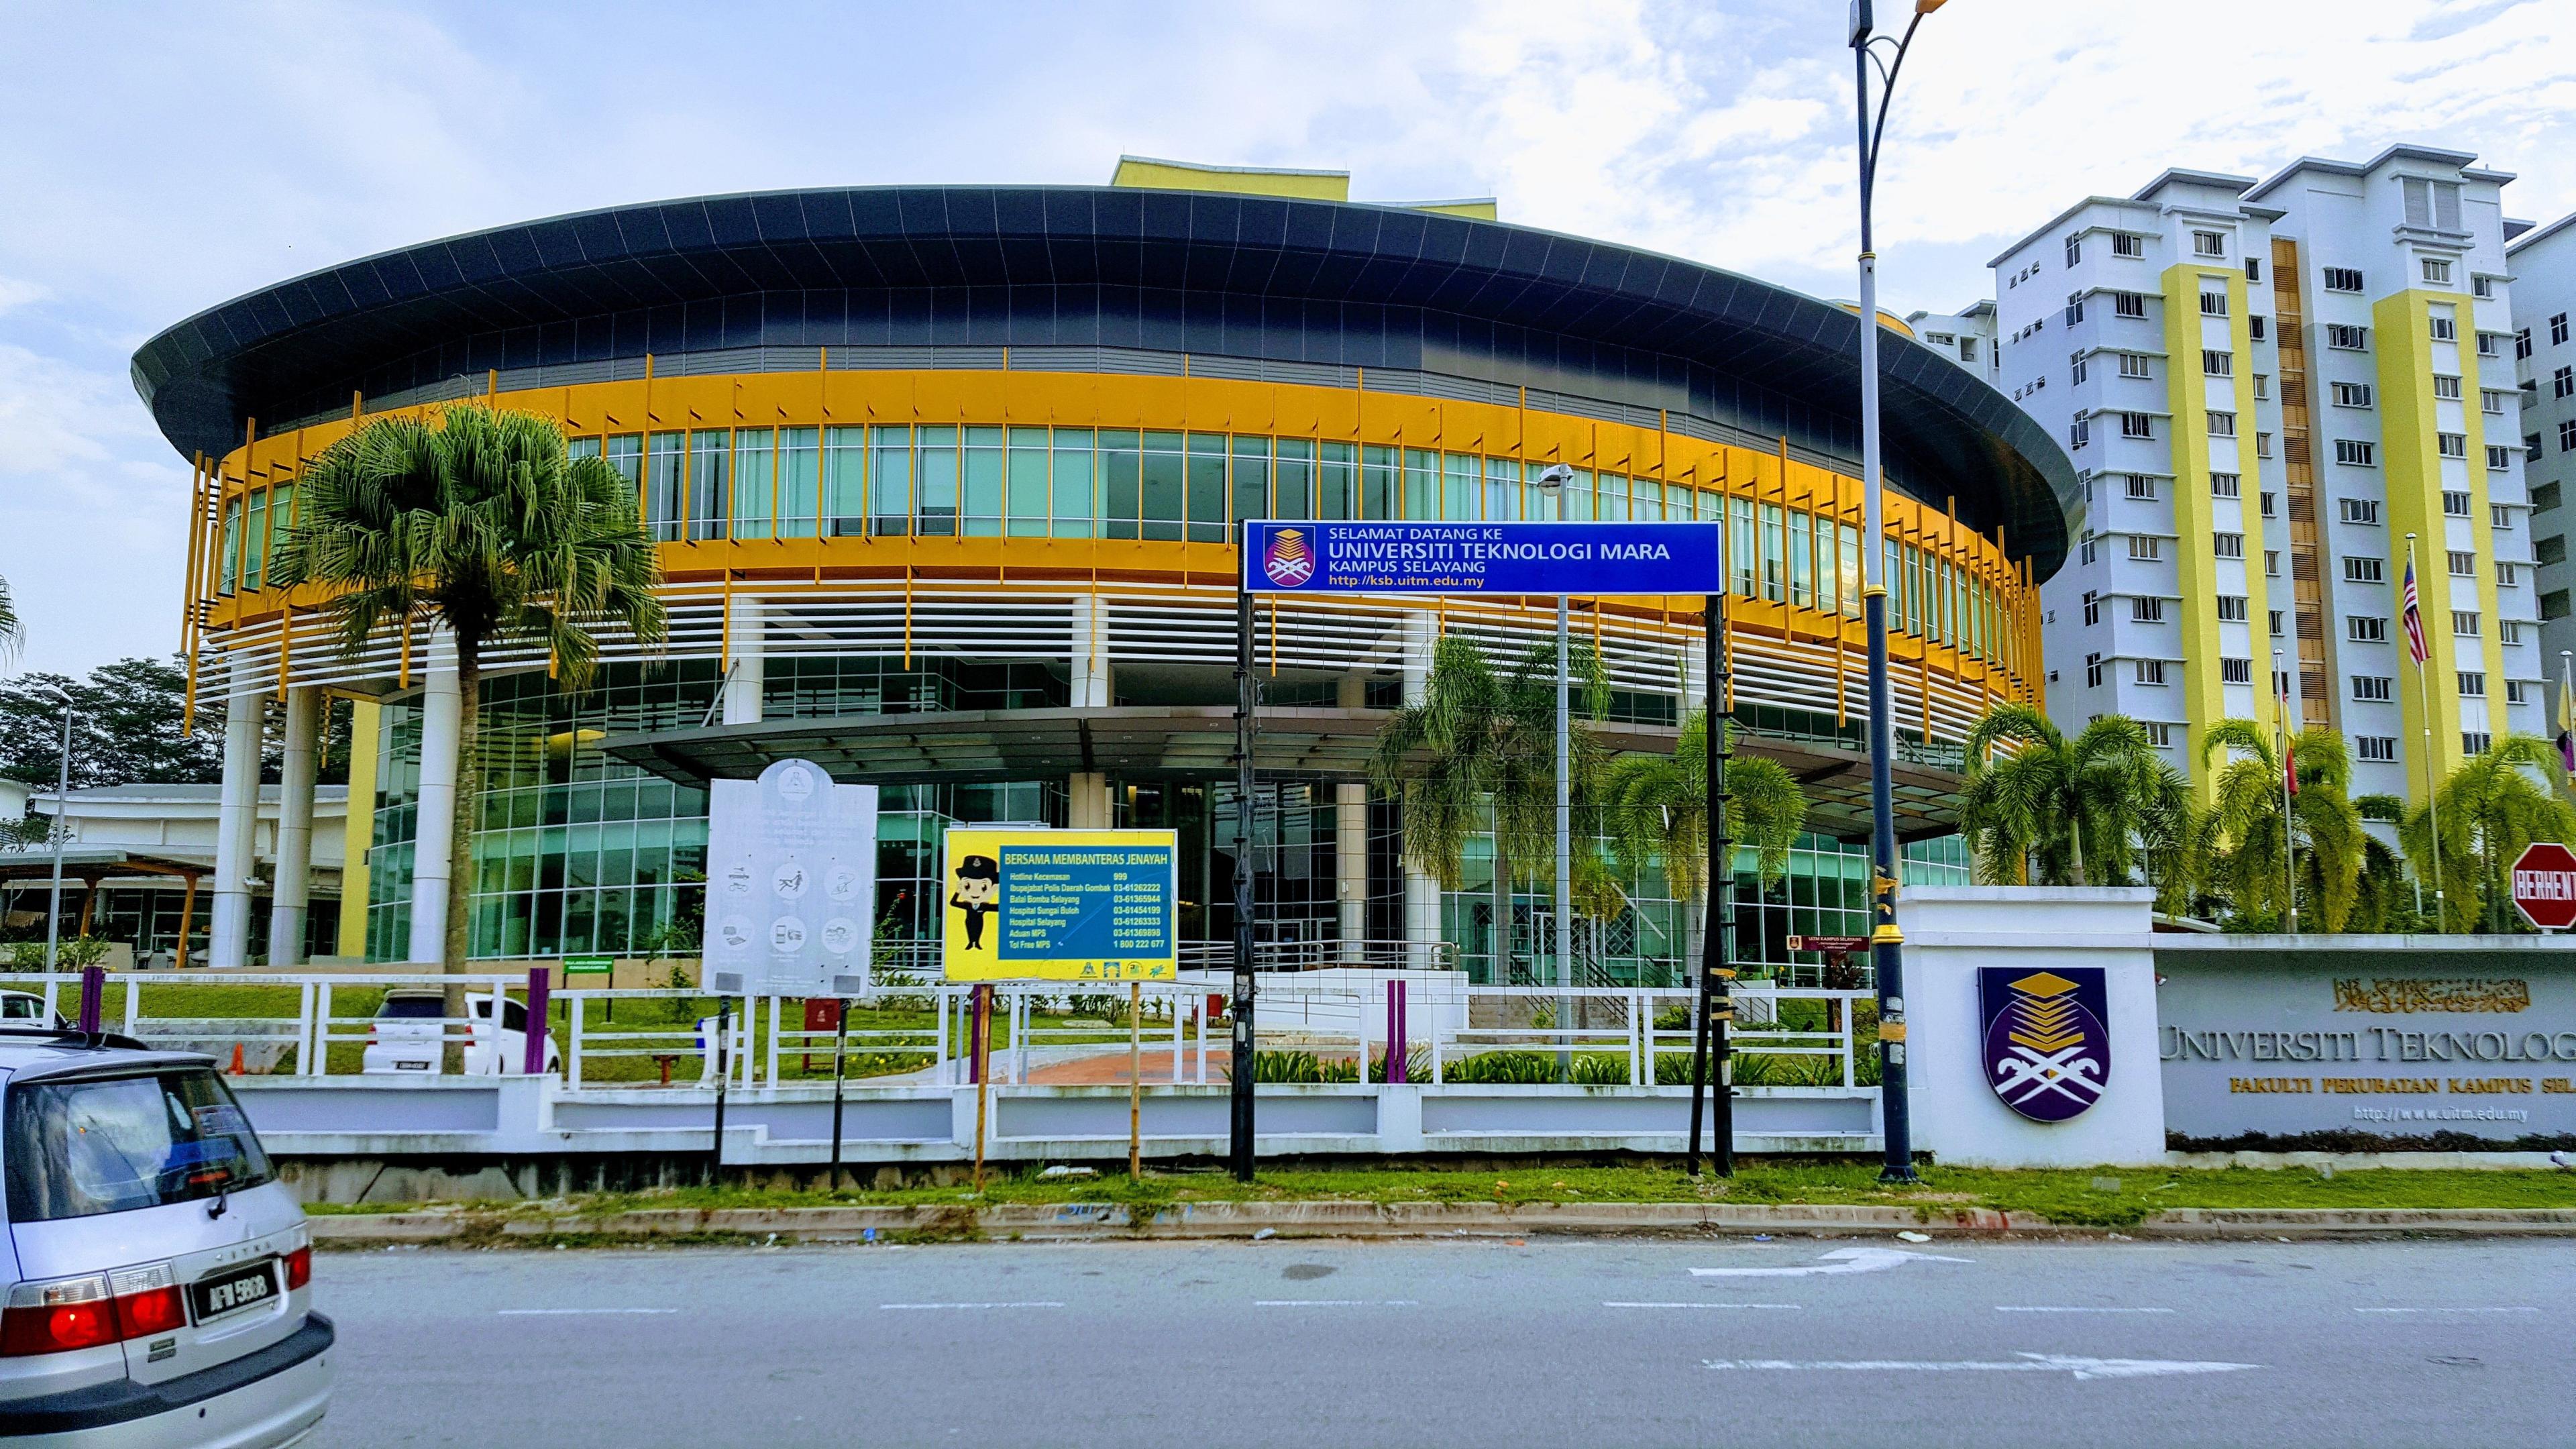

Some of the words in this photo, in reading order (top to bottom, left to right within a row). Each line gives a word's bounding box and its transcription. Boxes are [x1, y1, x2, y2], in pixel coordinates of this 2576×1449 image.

[1329, 528, 1404, 539] SELAMAT
[1410, 529, 1477, 540] DATANG
[1483, 529, 1502, 540] KE
[1329, 543, 1453, 559] UNIVERSITI
[1460, 543, 1591, 559] TEKNOLOGI
[1601, 544, 1670, 559] MARA
[1329, 561, 1397, 572] KAMPUS
[1403, 561, 1485, 573] SELAYANG
[1329, 575, 1484, 588] http://ksb.uitm.edu.my
[1005, 853, 1051, 865] BERSAMA
[1053, 853, 1124, 865] MEMBANTERAS
[1126, 853, 1167, 865] JENAYAH
[1051, 896, 1079, 904] Selayang
[1010, 907, 1036, 916] Hospital
[1037, 907, 1059, 916] Sungai
[1113, 906, 1161, 914] 03-61454199
[1010, 918, 1036, 926] Hospital
[1037, 918, 1066, 927] Selayang
[1113, 918, 1161, 926] 03-61263333
[1031, 929, 1046, 937] MPS
[1020, 941, 1034, 949] Free
[1036, 941, 1051, 949] MPS
[1136, 940, 1149, 948] 222
[1150, 940, 1165, 948] 677
[2158, 1024, 2361, 1061] UNIVERSITI
[2367, 1026, 2576, 1061] TEKNOLOG
[2229, 1077, 2312, 1093] FAKULTI
[2322, 1077, 2439, 1093] PERUBATAN
[2447, 1077, 2532, 1093] KAMPUS
[2354, 1106, 2528, 1123] http://www.uitm.edu.my
